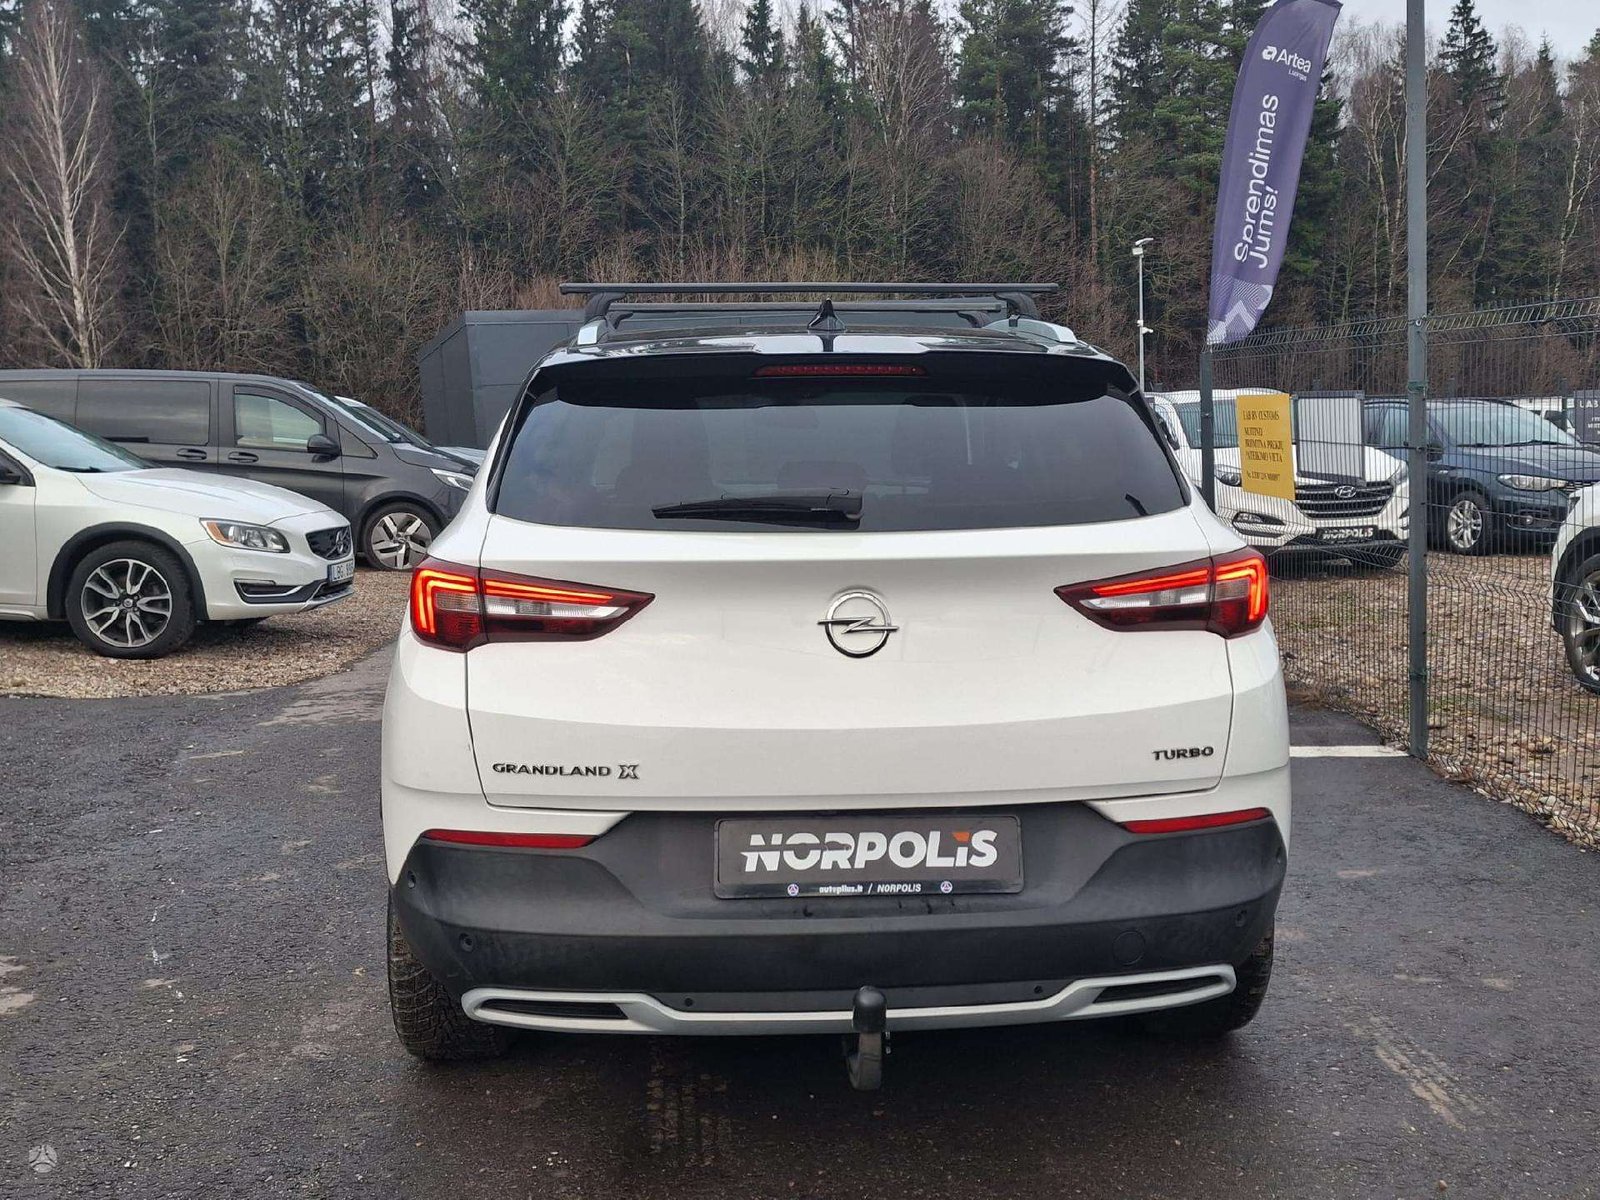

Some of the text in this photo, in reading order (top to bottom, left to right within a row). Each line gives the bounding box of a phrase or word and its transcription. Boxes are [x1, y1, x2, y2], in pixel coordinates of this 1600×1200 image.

[1276, 48, 1312, 73] Artea
[1234, 94, 1279, 264] Sprendimas
[1249, 185, 1279, 270] Jums!
[1151, 746, 1214, 761] TURBO
[492, 762, 640, 780] GRANDLAND X
[877, 883, 922, 893] NORPOLIS
